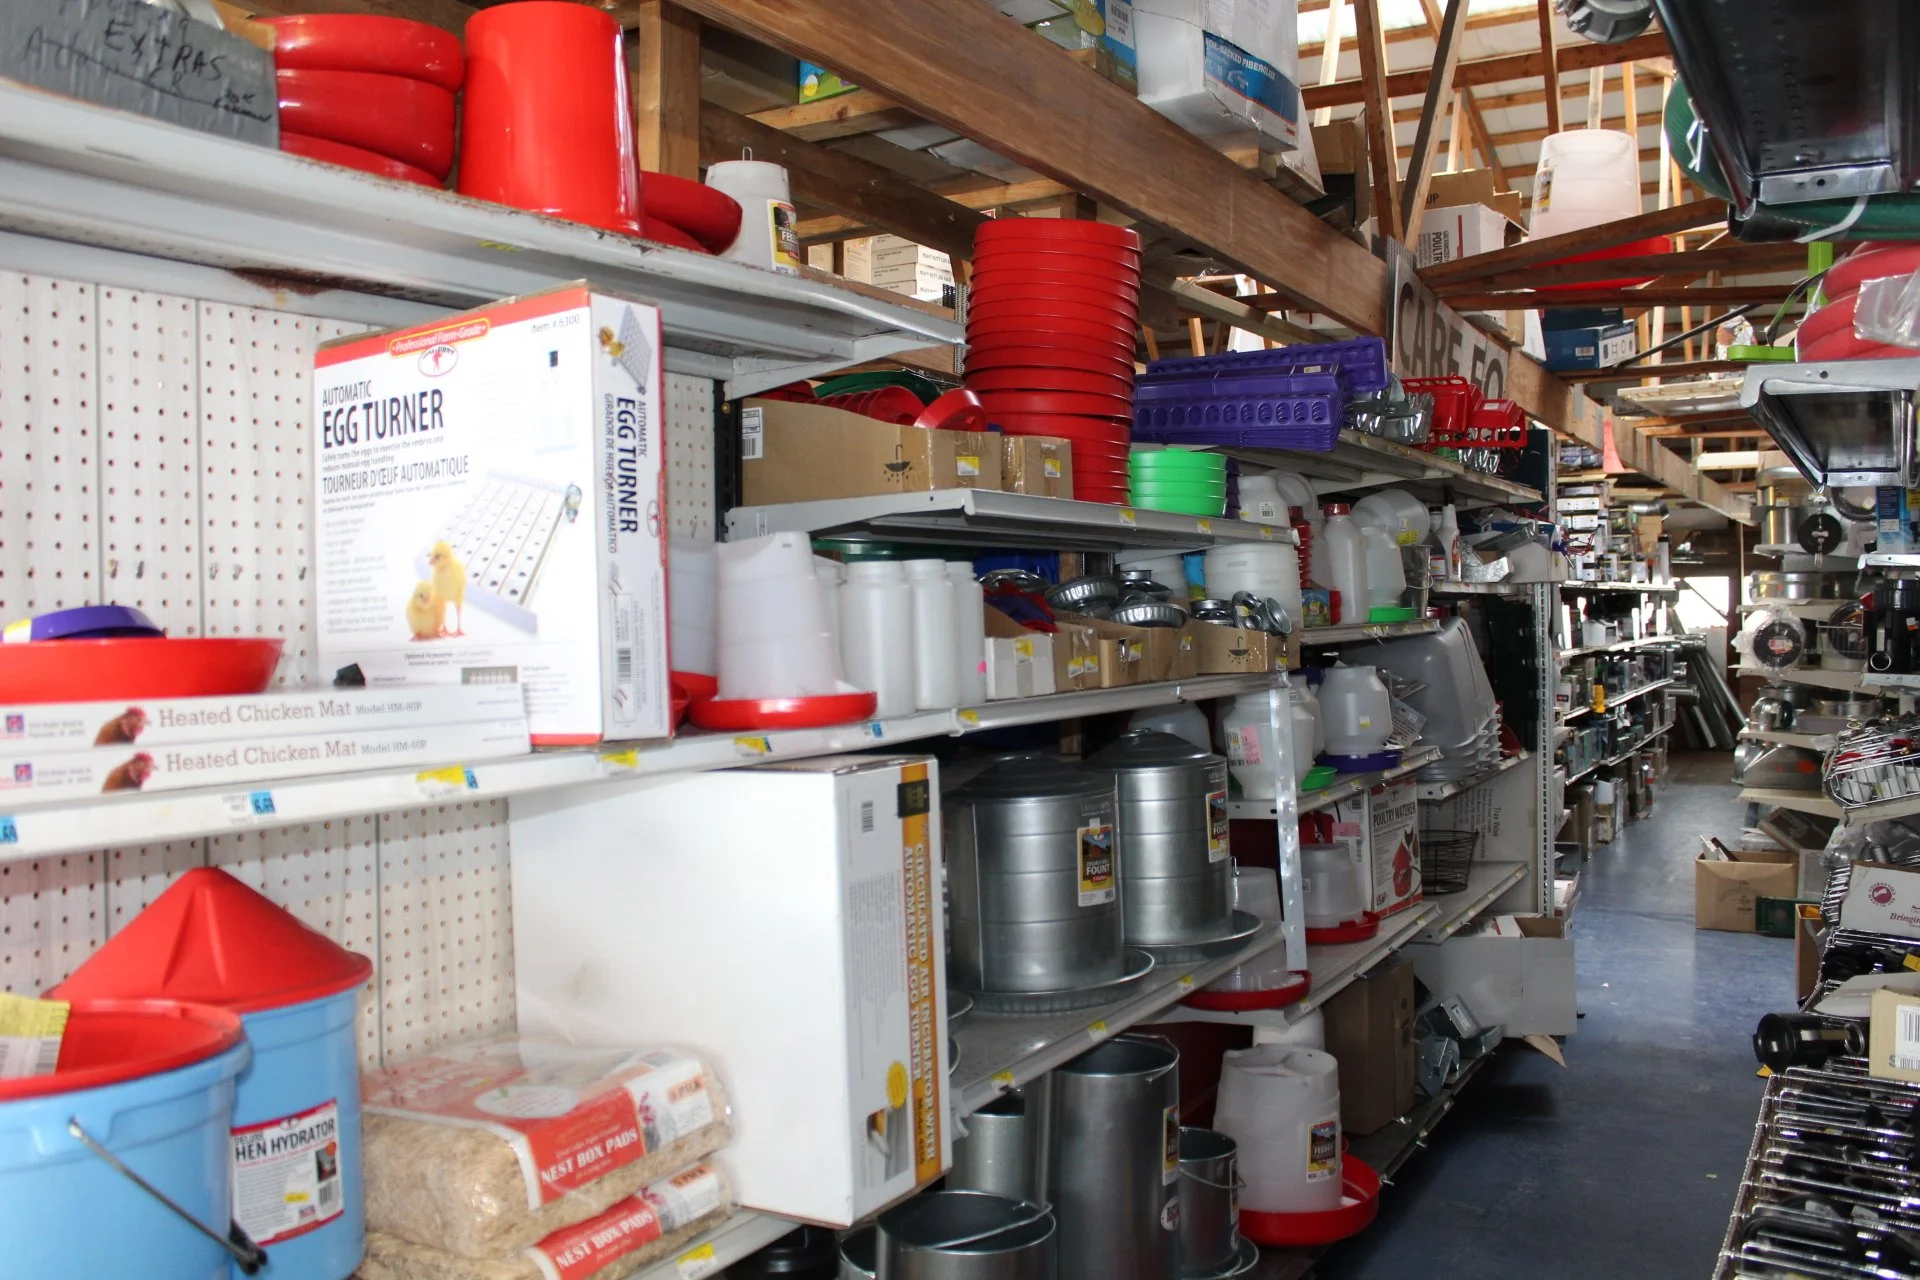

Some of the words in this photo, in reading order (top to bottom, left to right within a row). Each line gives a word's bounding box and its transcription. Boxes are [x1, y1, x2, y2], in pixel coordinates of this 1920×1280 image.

[322, 379, 372, 408] AUTOMATIC
[604, 393, 614, 437] GIRADOR
[323, 405, 358, 450] EGG
[362, 388, 444, 442] TURNER
[616, 397, 637, 440] EGG
[636, 401, 647, 458] AUTOMATIC
[401, 441, 411, 450] the
[411, 436, 432, 448] embryo
[605, 437, 615, 451] DE
[322, 470, 369, 495] TOURNEUR
[400, 455, 470, 483] AUTOMATIQUE
[617, 446, 639, 533] TURNER
[158, 706, 233, 729] Heated
[236, 702, 315, 725] Chicken
[319, 699, 352, 718] Mat
[355, 704, 386, 716] Model
[165, 751, 239, 774] Heated
[243, 745, 321, 766] Chicken
[324, 740, 357, 758] Mat
[360, 744, 391, 756] Model
[1373, 808, 1395, 828] POULTRY
[1395, 801, 1417, 820] WATERER
[1086, 863, 1110, 876] FOUNT
[904, 846, 917, 959] AUTOMATIC
[915, 843, 929, 962] CIRCULATED
[908, 963, 918, 1004] EGG
[911, 1008, 921, 1081] TURNER
[921, 1003, 934, 1110] INCUBATOR
[235, 1140, 267, 1162] HEN
[271, 1117, 335, 1153] HYDRATOR
[541, 1158, 575, 1183] NEST
[576, 1146, 604, 1168] BOX
[605, 1128, 638, 1153] PADS
[925, 1111, 936, 1160] WITH
[555, 1241, 592, 1270] NEST
[591, 1227, 622, 1250] BOX
[620, 1211, 654, 1233] PADS
